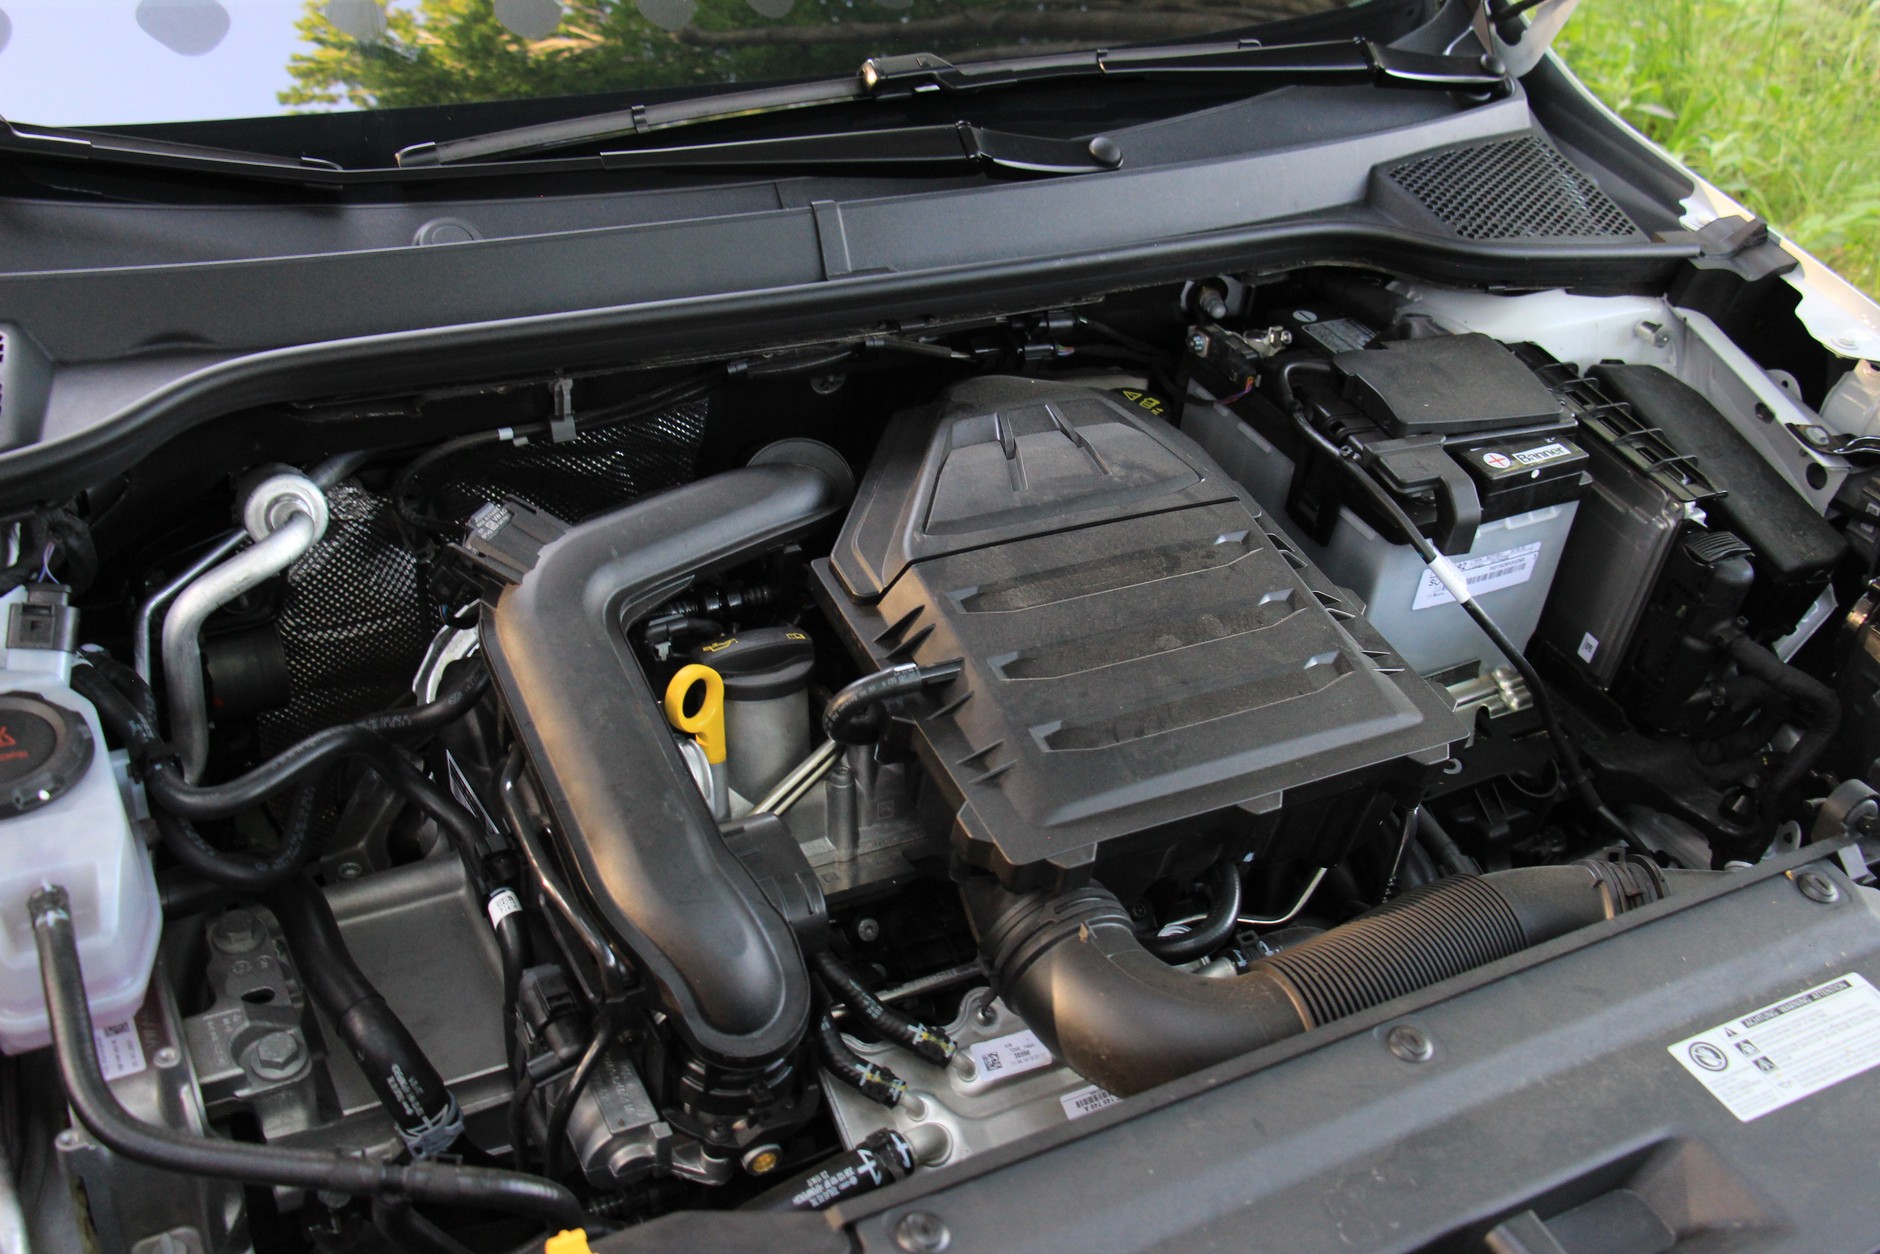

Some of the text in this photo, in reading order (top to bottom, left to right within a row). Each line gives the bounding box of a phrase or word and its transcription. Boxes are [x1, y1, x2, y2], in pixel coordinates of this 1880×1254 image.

[1516, 447, 1564, 463] Banner
[1743, 981, 1848, 1028] ACHTUNG WARNING ATTENTION
